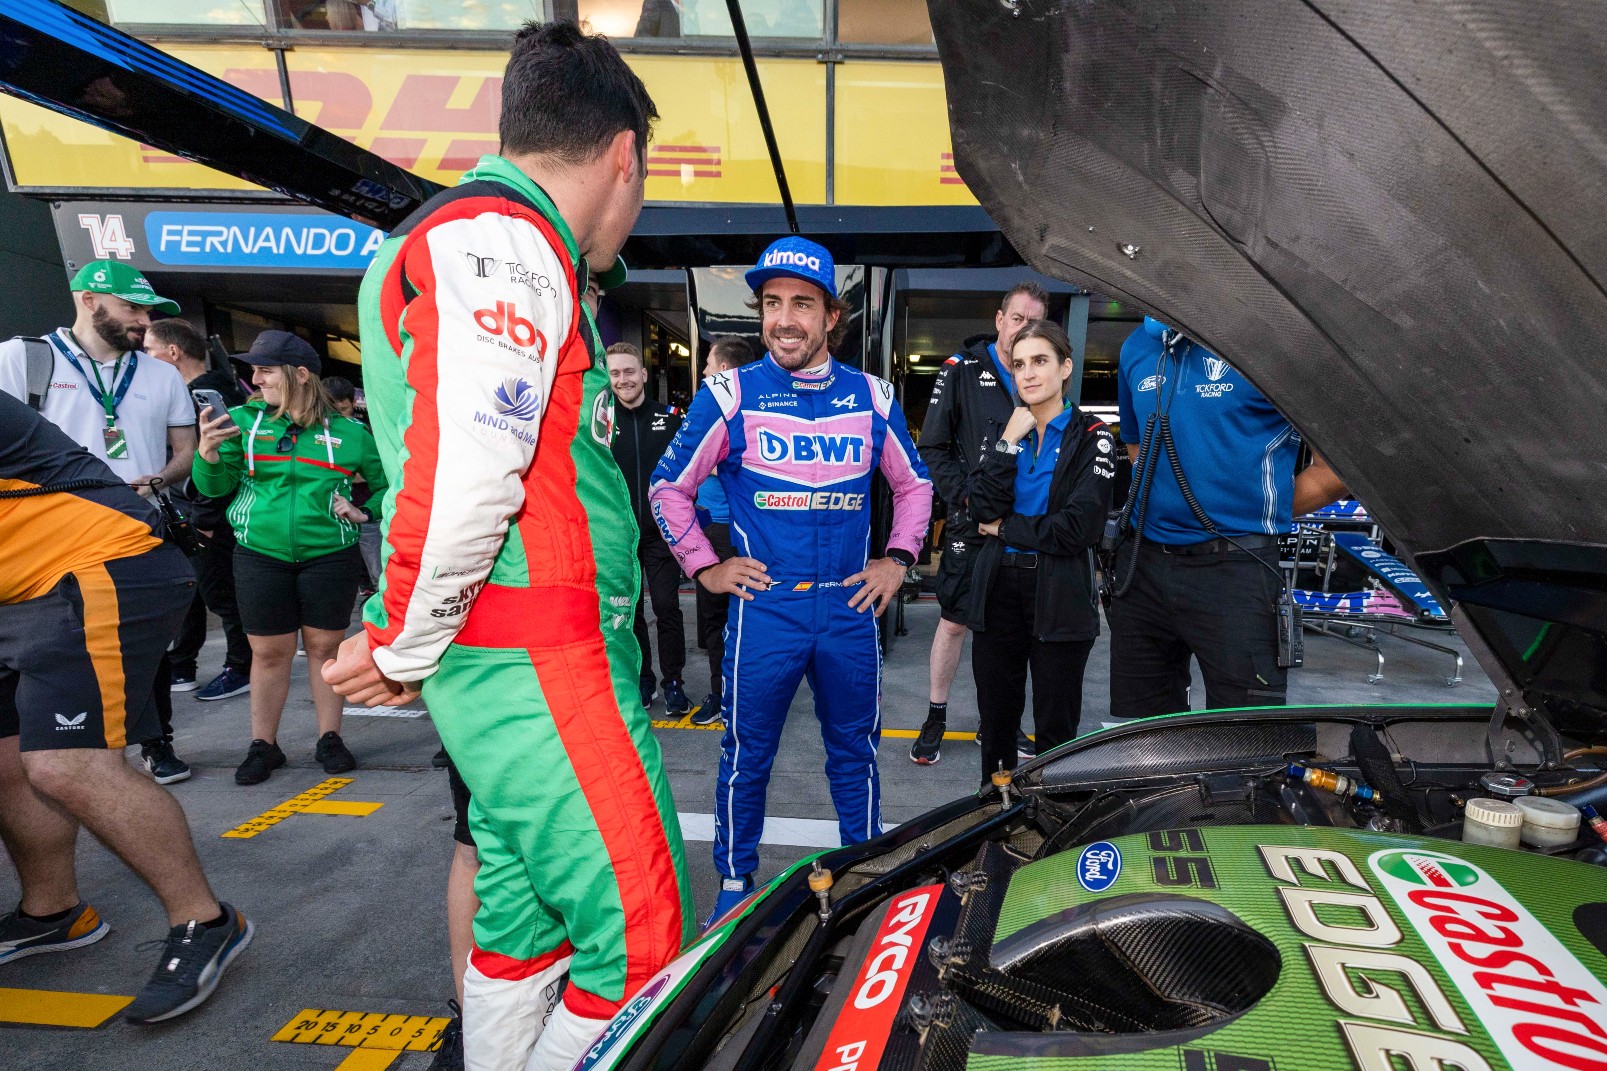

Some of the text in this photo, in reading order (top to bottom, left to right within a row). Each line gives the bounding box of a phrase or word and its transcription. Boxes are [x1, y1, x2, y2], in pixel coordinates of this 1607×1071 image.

[78, 213, 135, 259] 14
[160, 225, 355, 256] FERNANDO
[763, 249, 820, 272] kimoa
[505, 262, 557, 298] TICFO
[476, 334, 495, 345] DISC
[498, 340, 526, 358] BRAKES
[52, 382, 78, 390] Castrol
[473, 410, 509, 431] MND
[523, 432, 536, 446] Me
[791, 434, 866, 466] BWT
[766, 491, 866, 511] Castrol EDGE
[1085, 850, 1115, 882] Ford
[854, 893, 931, 1010] RYCO
[1256, 844, 1496, 1071] EDGE
[295, 1019, 317, 1030] 20
[321, 1022, 339, 1032] 15
[344, 1023, 361, 1034] 10
[366, 1025, 381, 1035] 5
[389, 1027, 402, 1037] 0
[412, 1028, 425, 1038] 5
